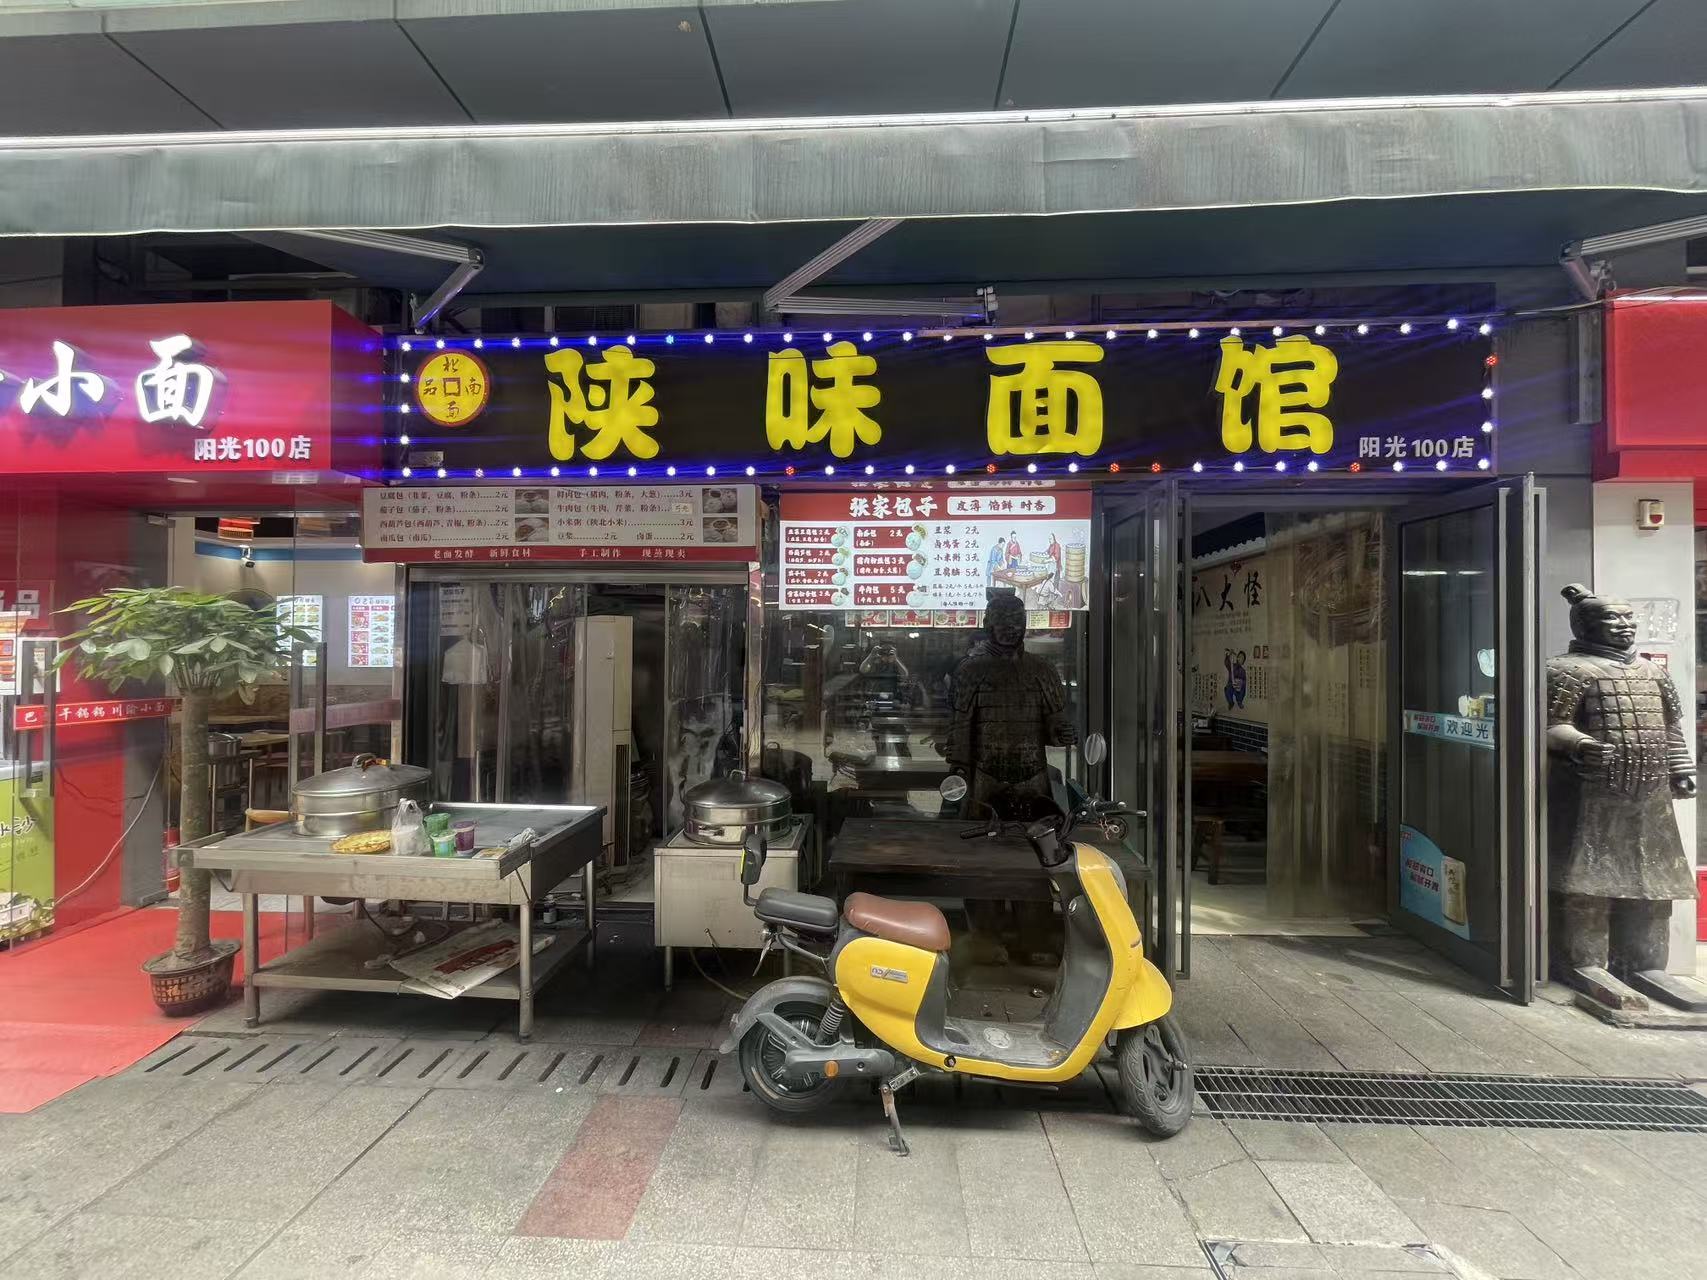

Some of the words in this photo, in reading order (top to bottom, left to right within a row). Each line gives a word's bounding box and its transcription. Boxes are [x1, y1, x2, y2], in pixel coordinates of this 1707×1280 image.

[0, 333, 216, 427] 小面
[543, 334, 1339, 462] 陕味面馆
[194, 434, 312, 461] 阳光100店
[1358, 435, 1475, 459] 阳光100店
[849, 494, 938, 518] 张家包子
[934, 526, 951, 534] 豆浆
[965, 526, 979, 534] 2元
[965, 540, 979, 548] 2元
[433, 550, 473, 559] 老面发酵
[489, 548, 531, 558] 新鲜食材
[579, 549, 621, 558] 手工制作
[934, 554, 960, 562] 小米粥
[965, 554, 980, 562] 3元
[965, 568, 980, 577] 5元
[1446, 719, 1494, 740] 欢迎光
